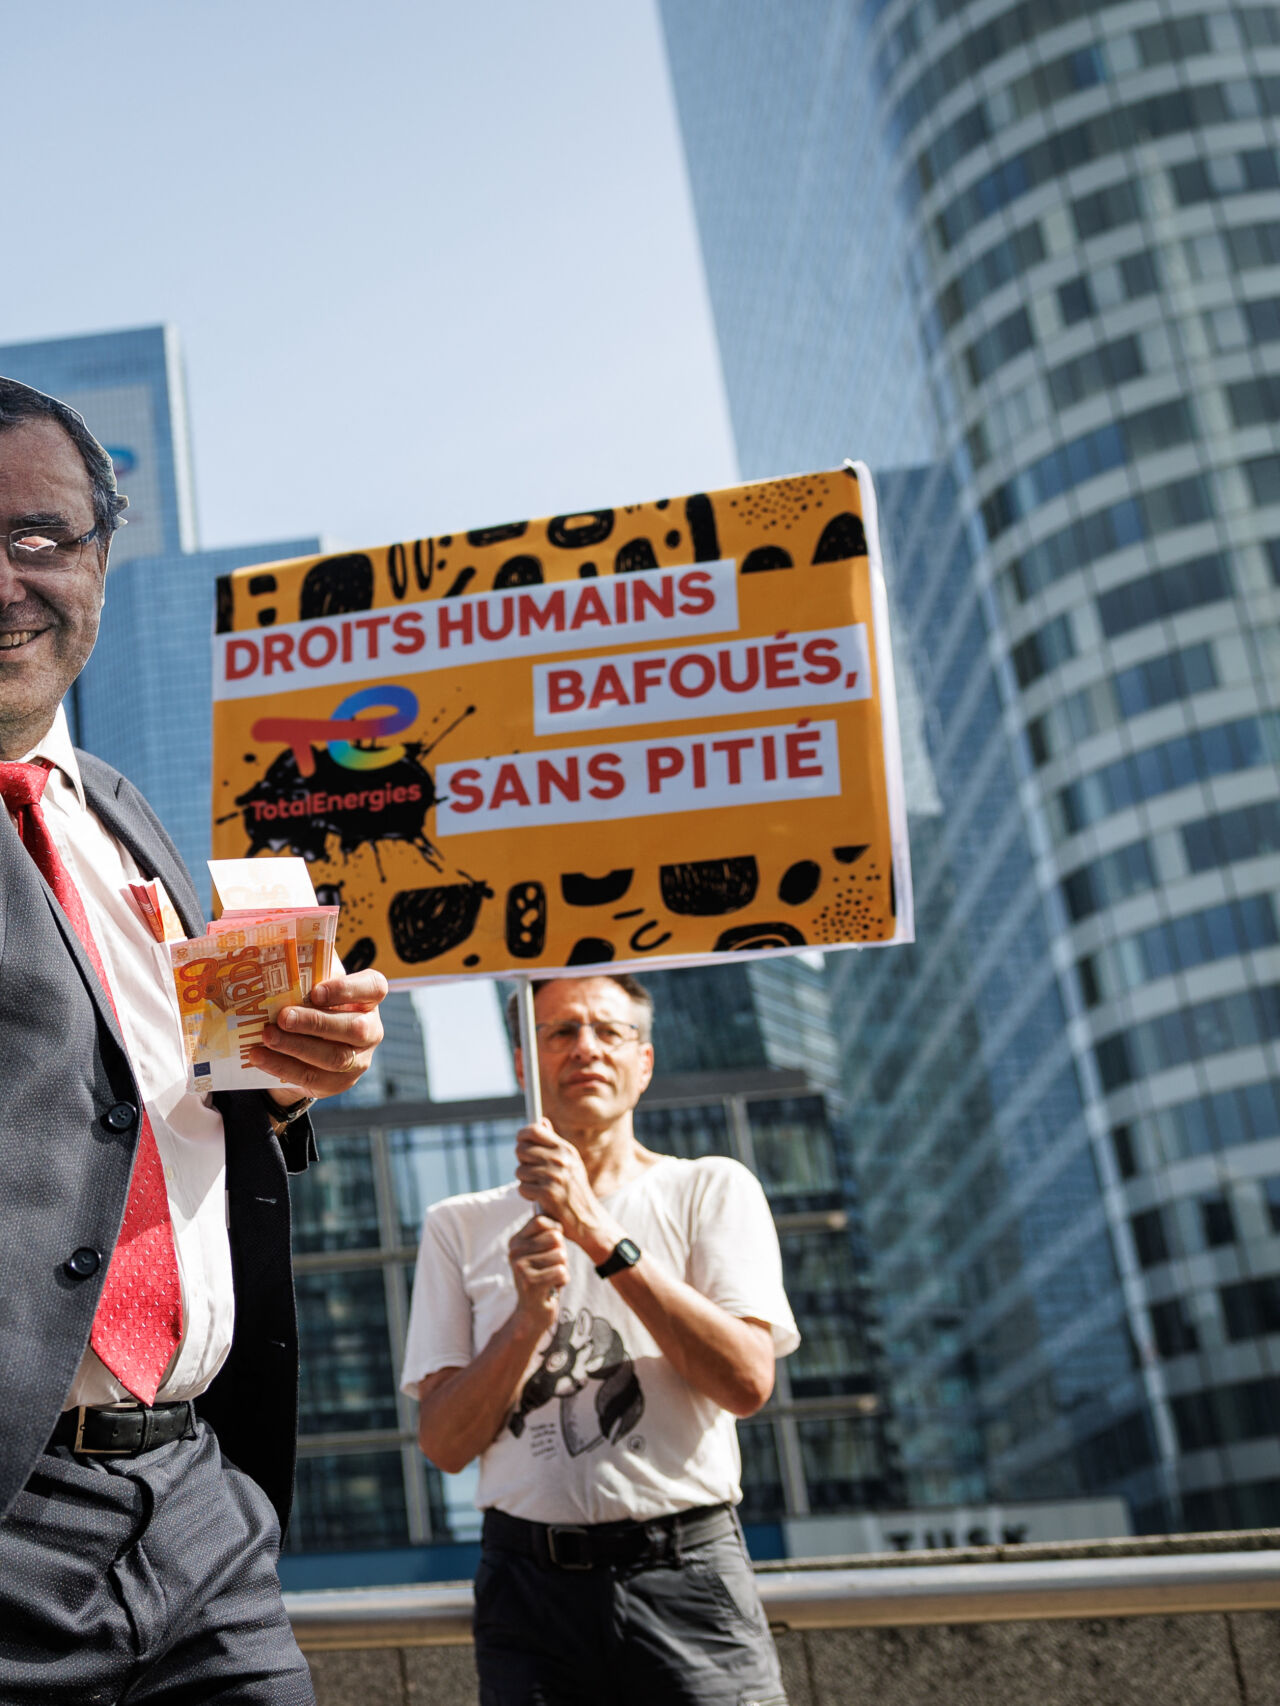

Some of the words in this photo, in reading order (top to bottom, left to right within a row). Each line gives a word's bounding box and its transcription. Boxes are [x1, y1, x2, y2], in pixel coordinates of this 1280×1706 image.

[224, 612, 427, 682] DROITS
[438, 570, 716, 648] HUMAINS
[546, 630, 859, 714] BAFOUÉS,
[250, 782, 422, 822] TotalEnergies
[448, 753, 625, 815] SANS
[646, 718, 825, 794] PITIÉ
